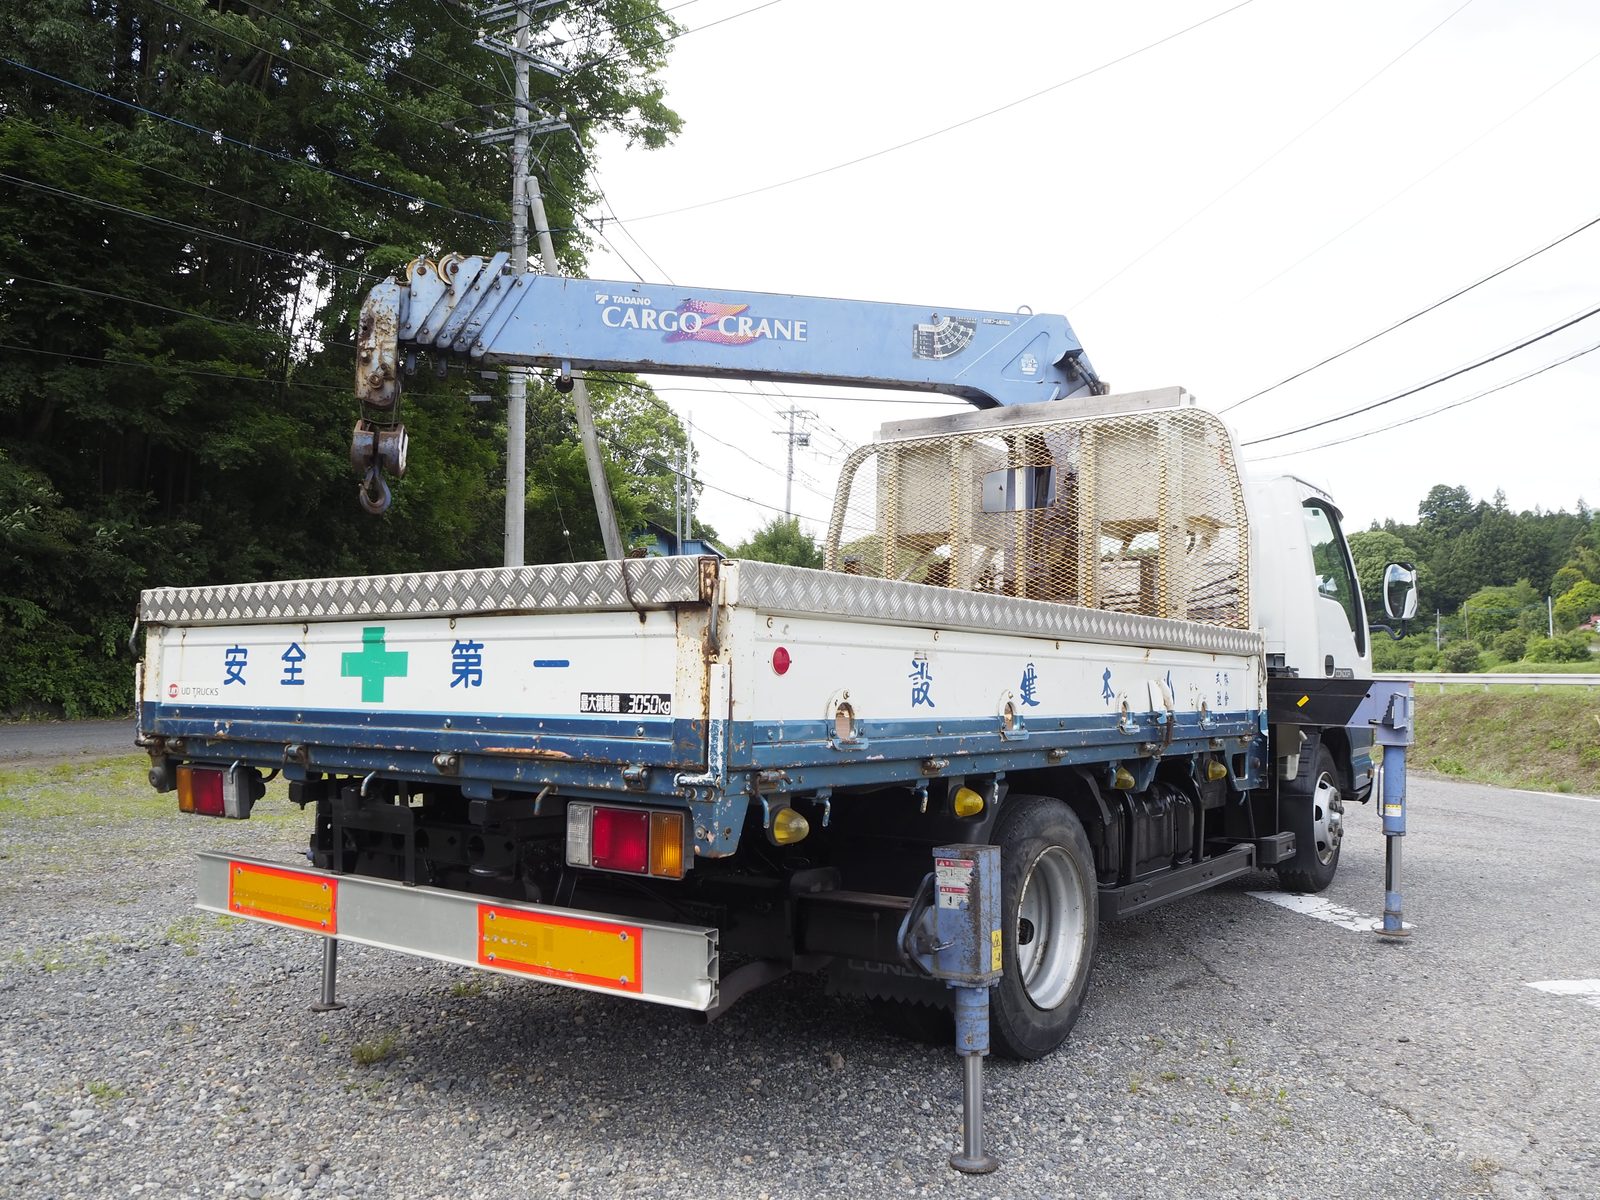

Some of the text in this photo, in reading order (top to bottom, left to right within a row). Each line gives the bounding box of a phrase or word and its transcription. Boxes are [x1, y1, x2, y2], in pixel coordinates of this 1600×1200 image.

[612, 294, 651, 306] TADANO
[601, 305, 703, 333] CARGO
[718, 314, 809, 343] CRANE
[181, 687, 219, 697] UD TRUCKS
[580, 694, 671, 715] 最大積載量 3050kg
